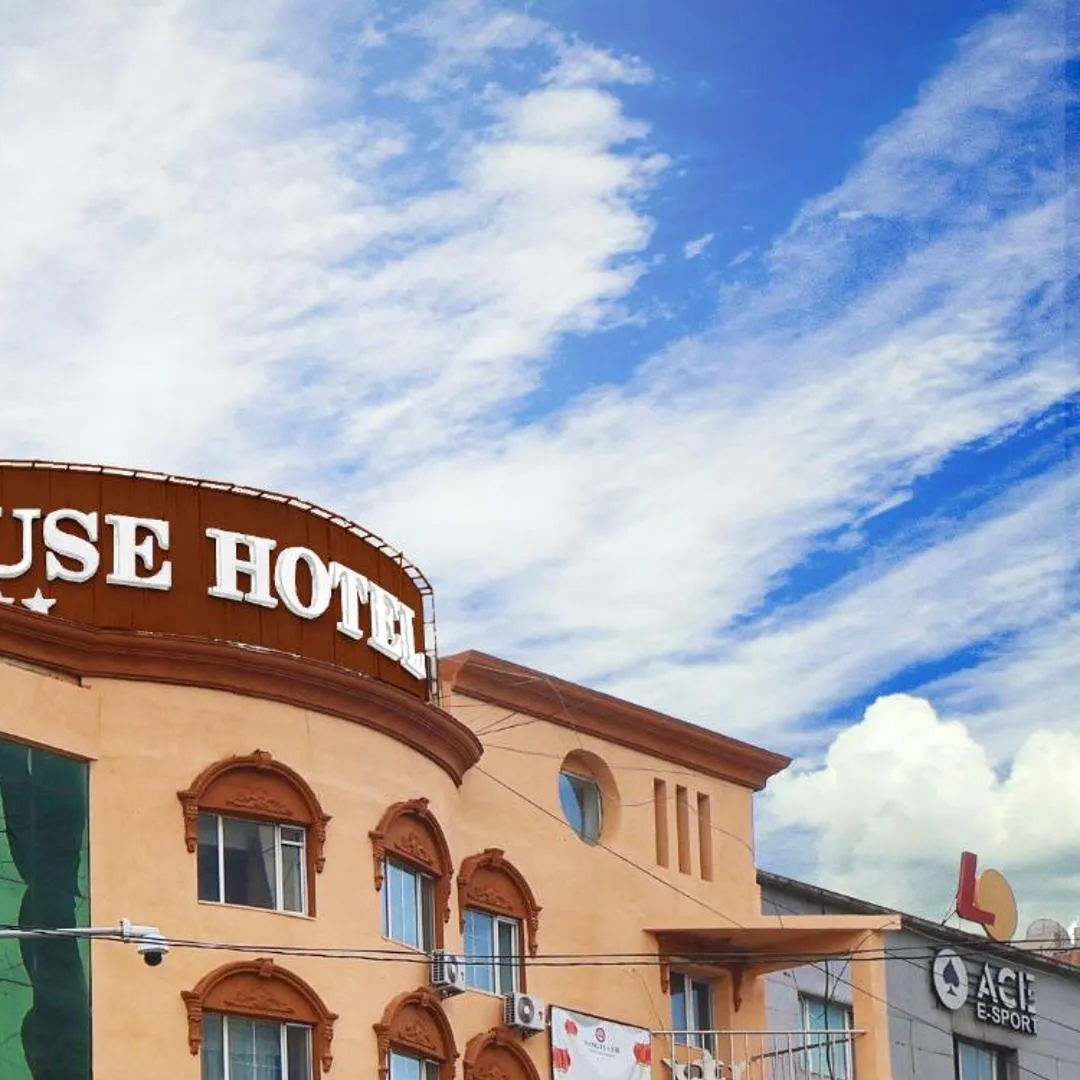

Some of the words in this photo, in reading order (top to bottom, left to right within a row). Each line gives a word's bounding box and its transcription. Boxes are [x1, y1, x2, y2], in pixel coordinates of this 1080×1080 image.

[205, 527, 427, 680] HOTEL
[977, 961, 1037, 1014] ACE
[977, 1001, 1039, 1035] E-SPORT
